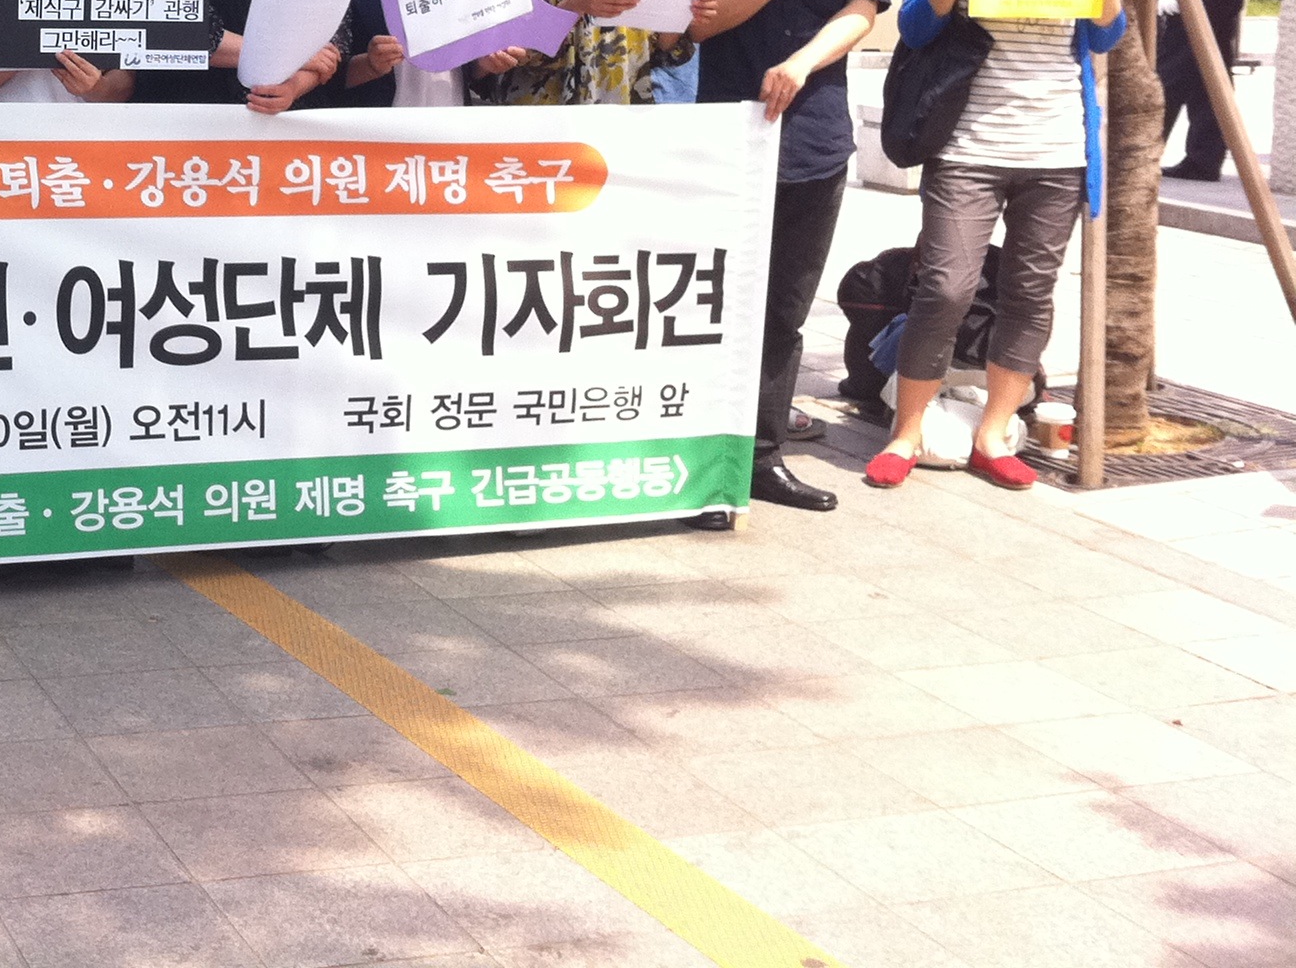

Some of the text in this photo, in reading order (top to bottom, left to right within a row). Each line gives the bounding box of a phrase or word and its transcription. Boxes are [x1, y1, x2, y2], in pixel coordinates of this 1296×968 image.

[164, 0, 200, 21] 관행
[42, 29, 142, 51] 그만해라~~!
[145, 53, 207, 64] 한국여성단체연합
[279, 155, 368, 207] 의원
[384, 155, 469, 206] 제명
[484, 156, 574, 205] 촉구
[423, 248, 728, 357] 기자회견
[129, 399, 267, 443] 오전11시
[343, 393, 411, 434] 국회
[430, 389, 497, 431] 정문
[512, 385, 644, 426] 국민은행
[659, 383, 690, 419] 앞
[204, 479, 277, 525] 의원
[295, 475, 366, 519] 제명
[383, 471, 456, 513] 촉구
